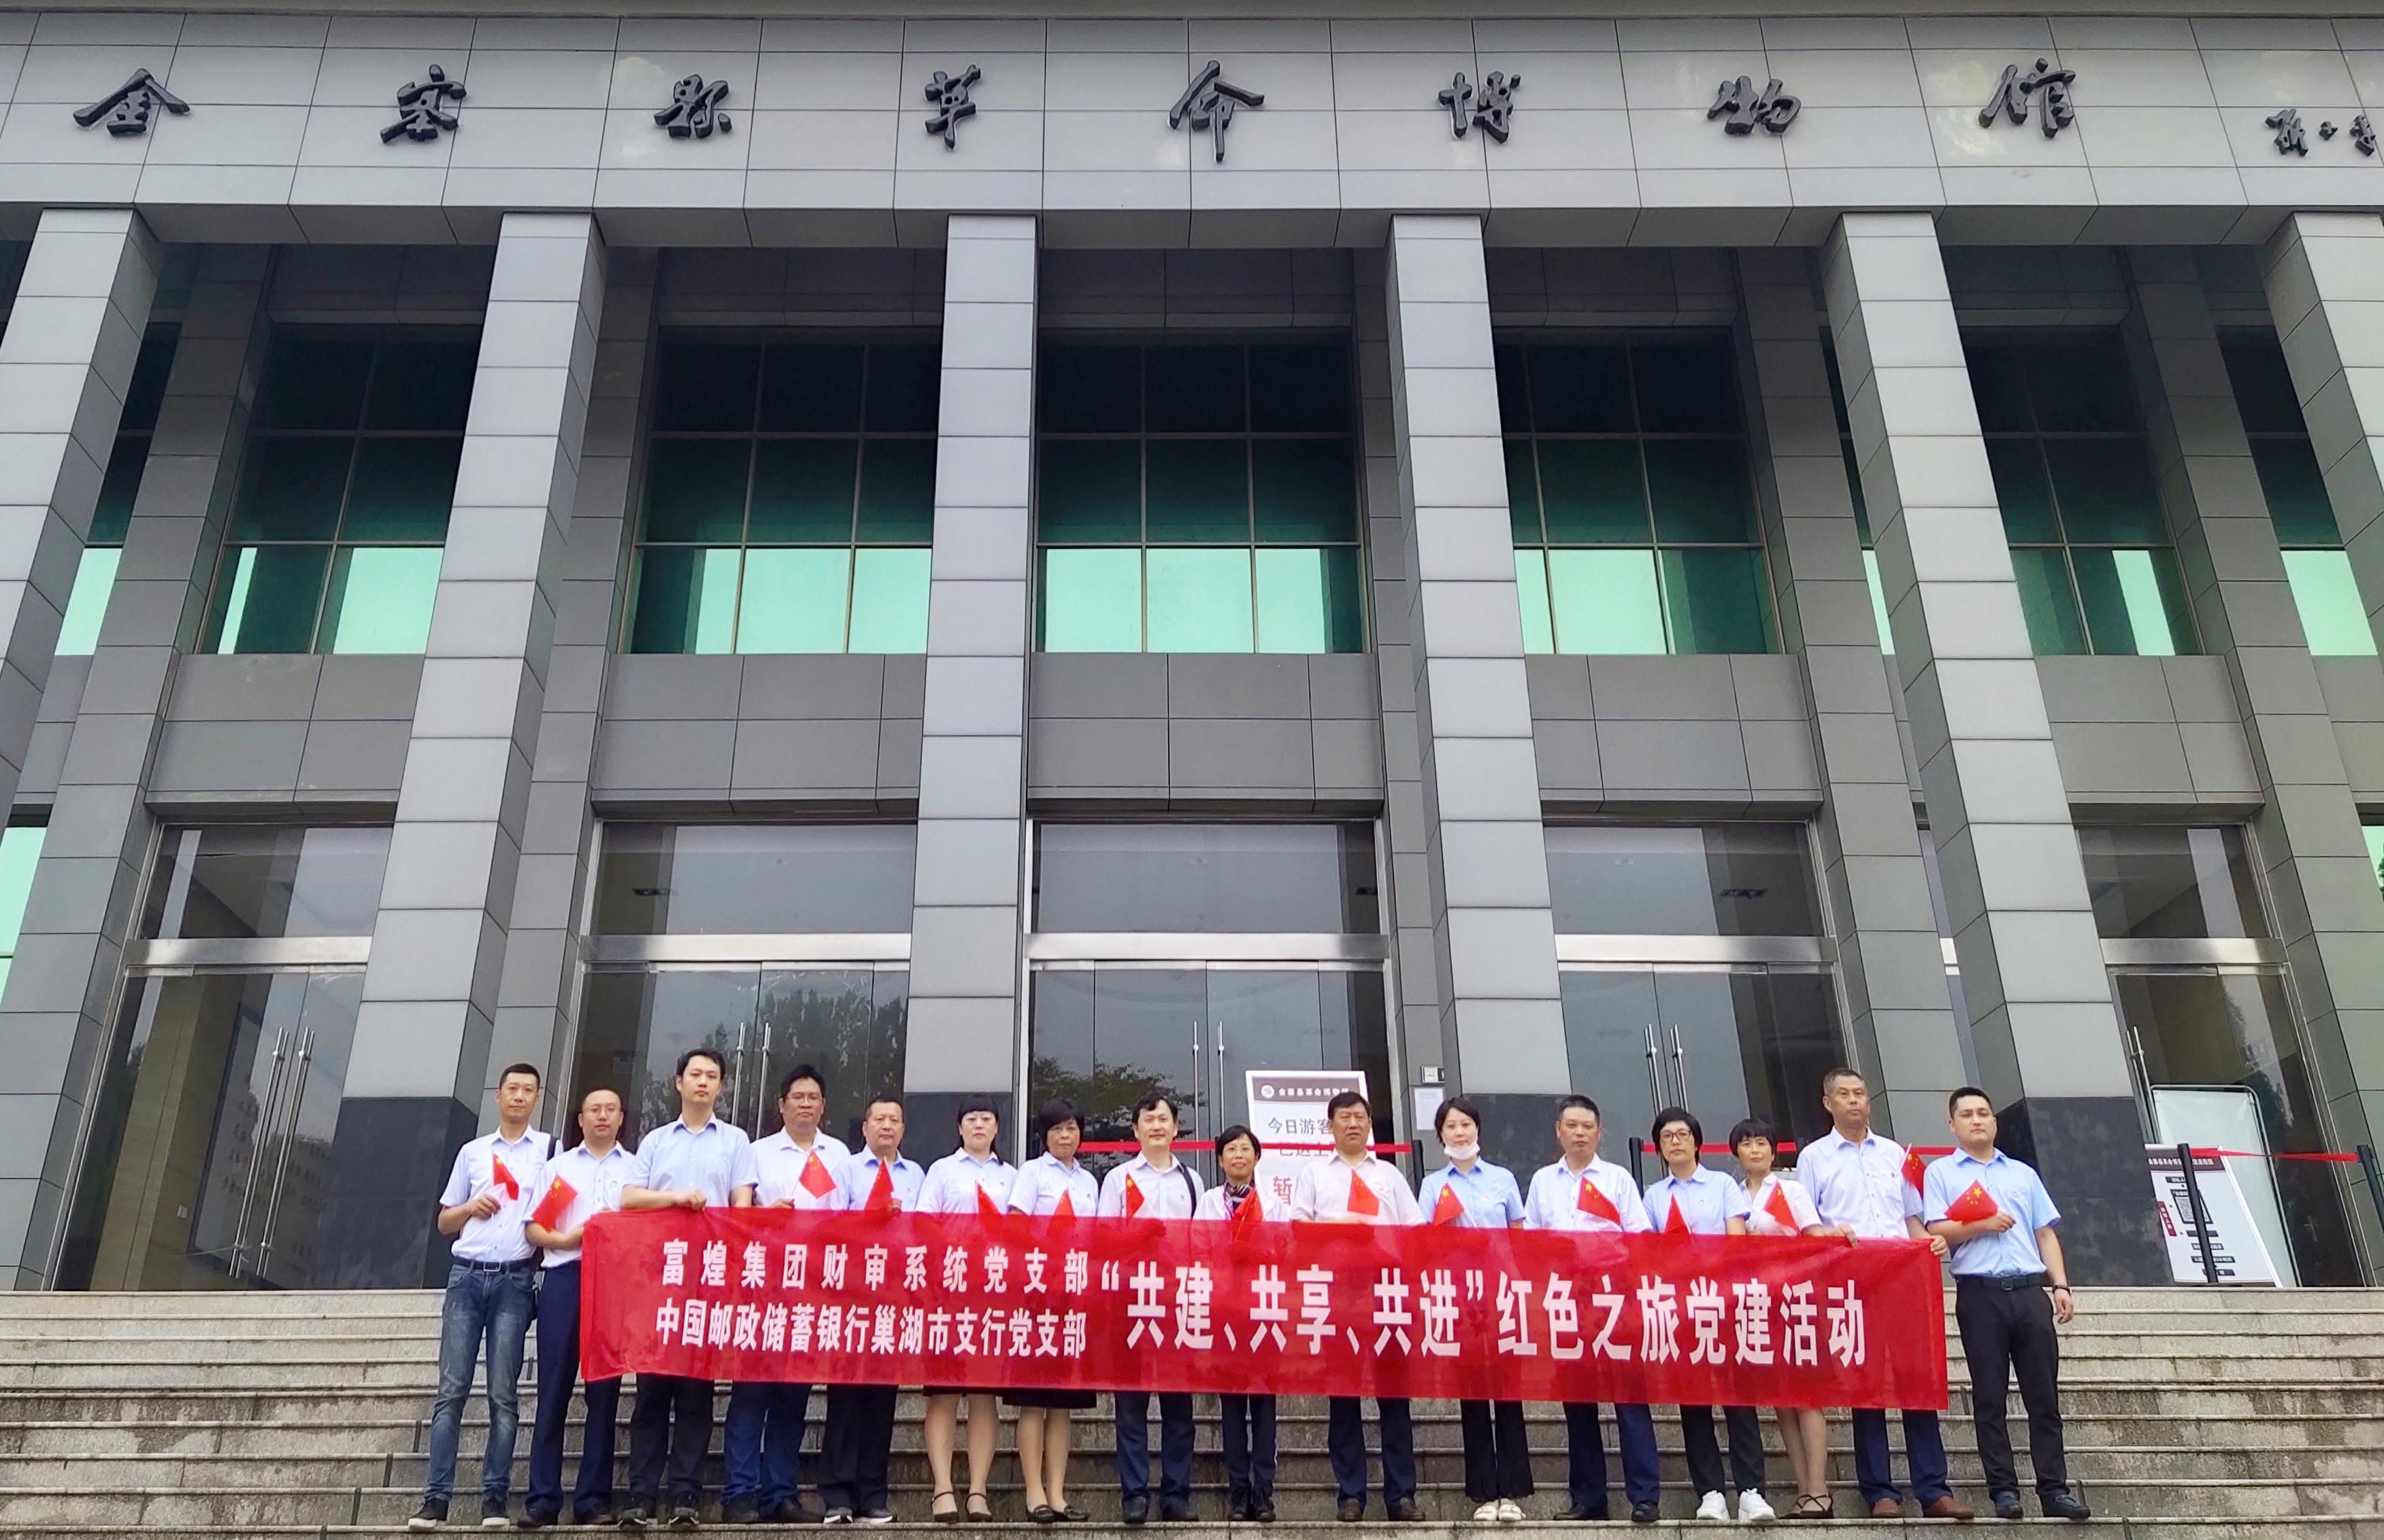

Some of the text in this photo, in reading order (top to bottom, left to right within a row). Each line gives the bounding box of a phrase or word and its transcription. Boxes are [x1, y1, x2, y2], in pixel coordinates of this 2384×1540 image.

[661, 1237, 1089, 1296] 富煌集团财审系统党支部
[654, 1296, 1088, 1359] 中国邮政储蓄银行巢湖市支行党支部
